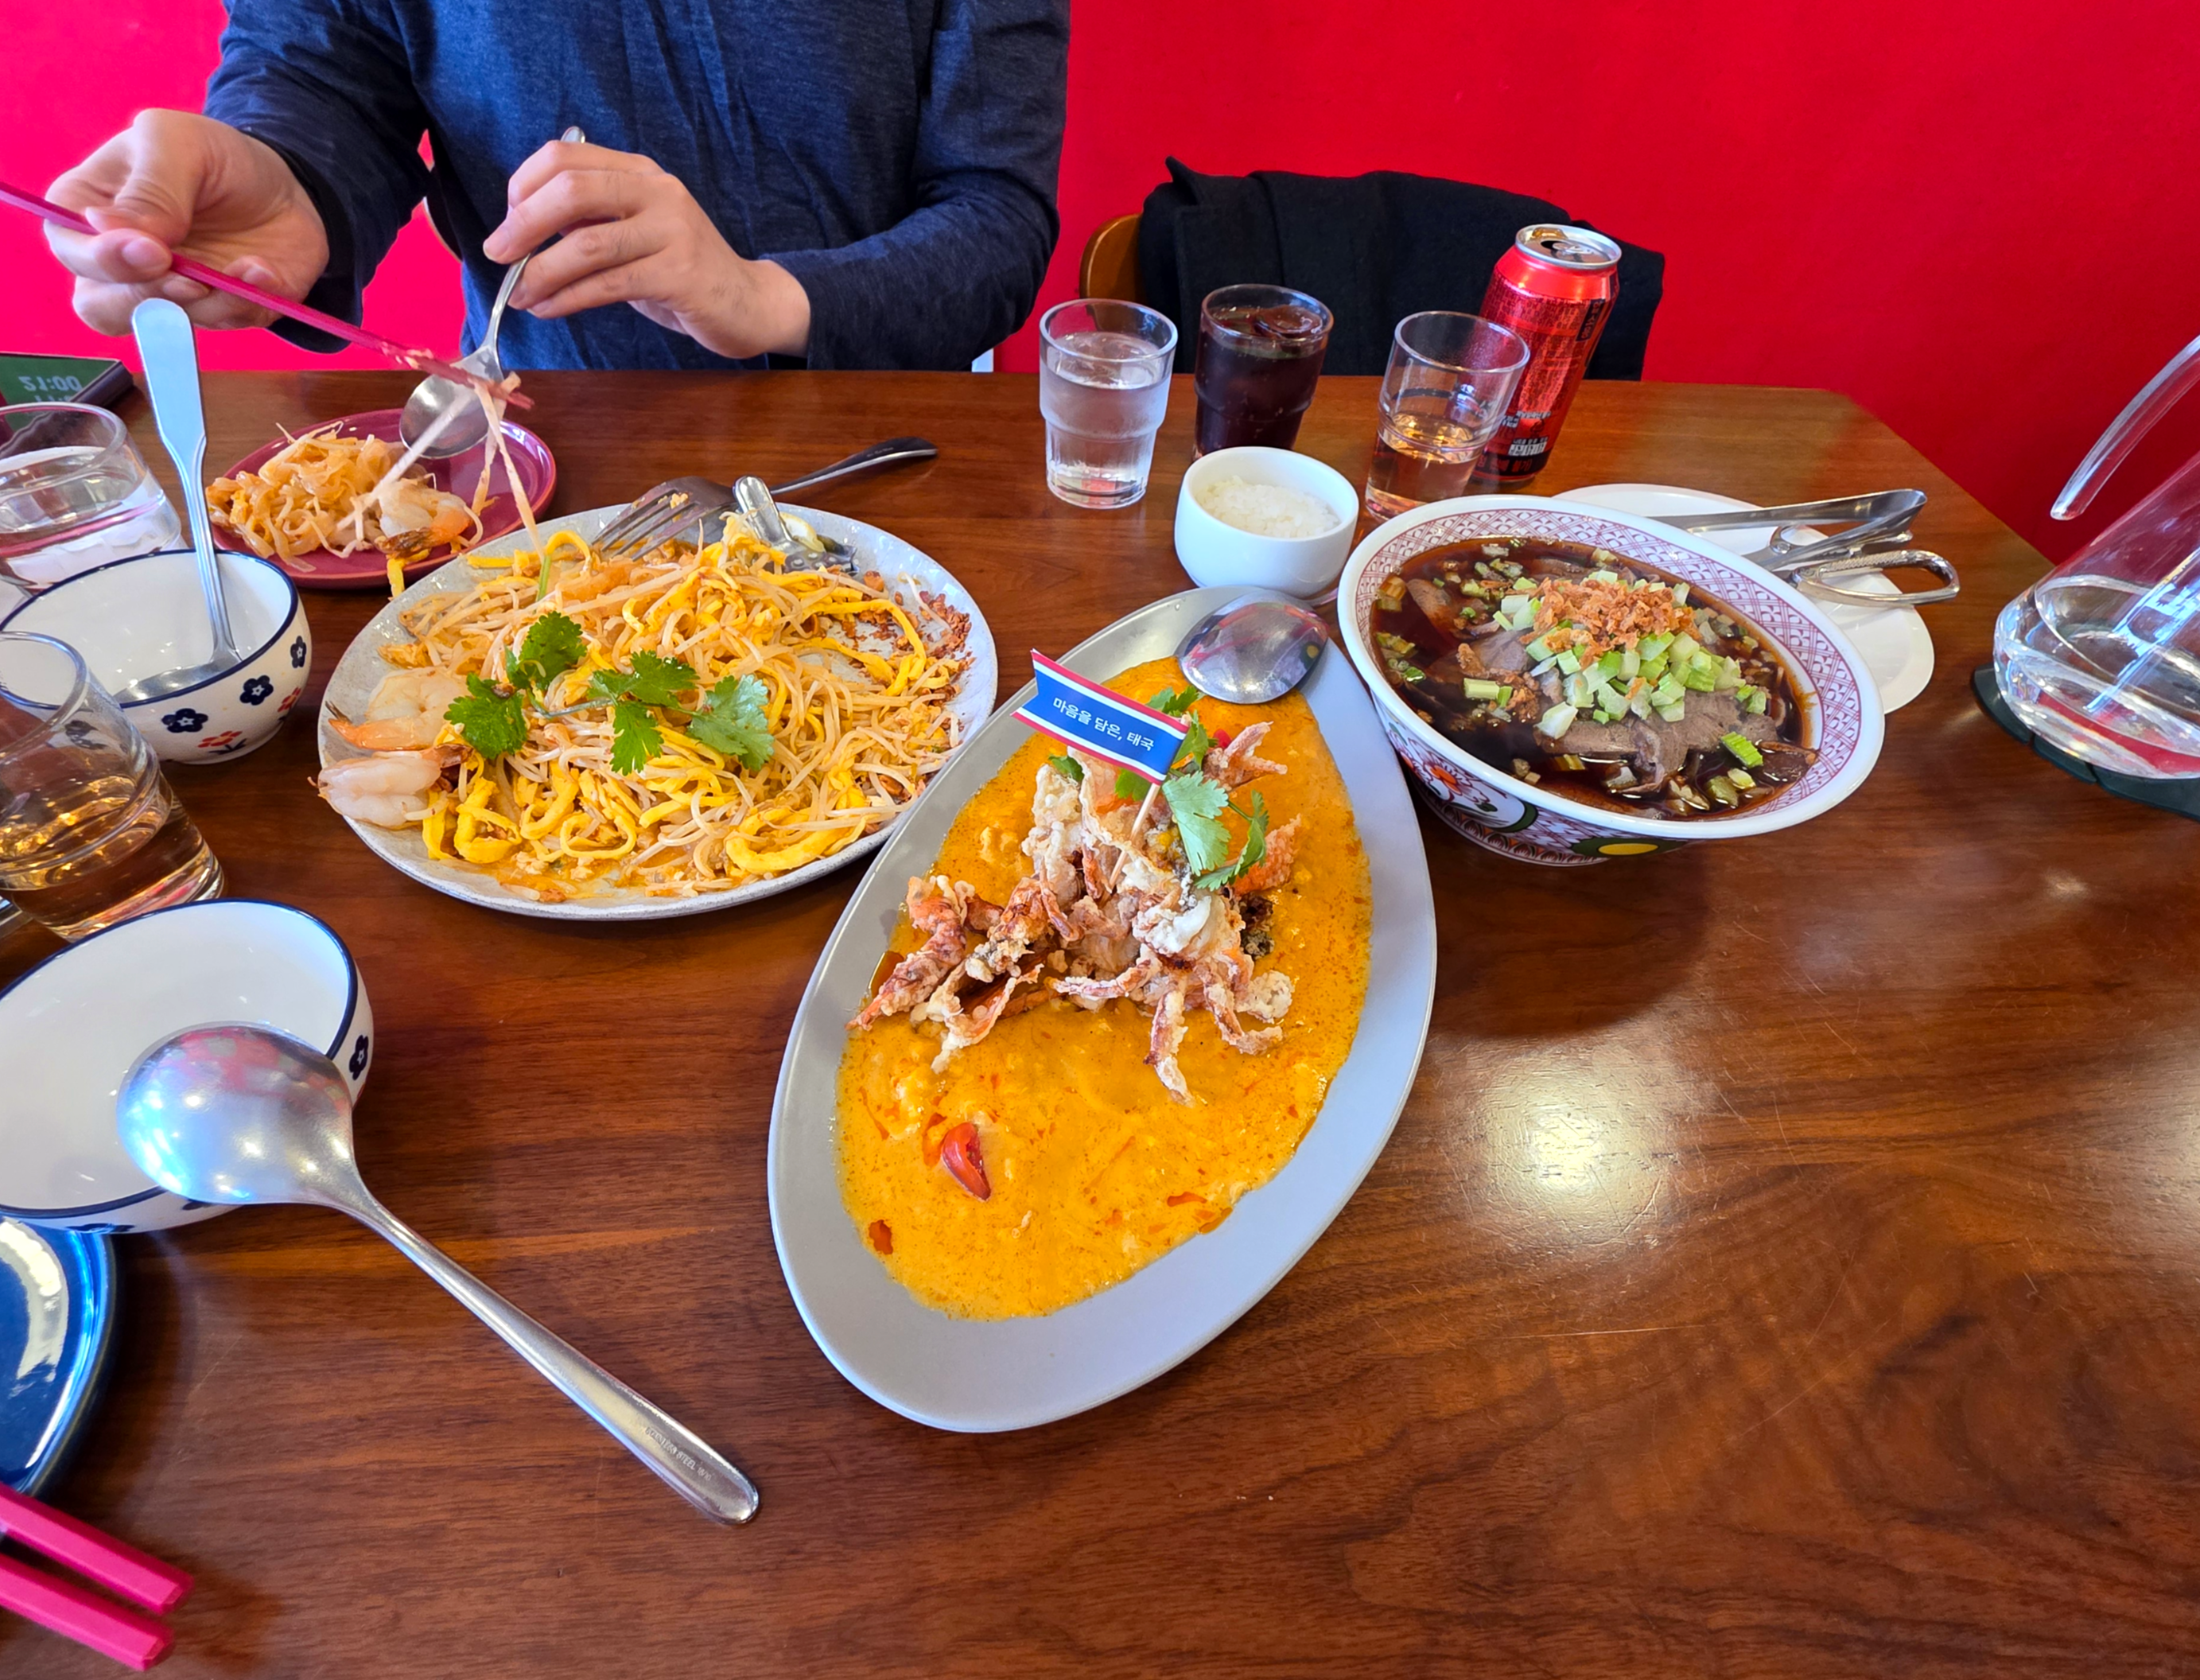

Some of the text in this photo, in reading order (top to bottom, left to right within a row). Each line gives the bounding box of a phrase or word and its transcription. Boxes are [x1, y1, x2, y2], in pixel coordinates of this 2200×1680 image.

[1052, 697, 1154, 752] 마음을 담은, 태국
[677, 1449, 697, 1471] STEEL
